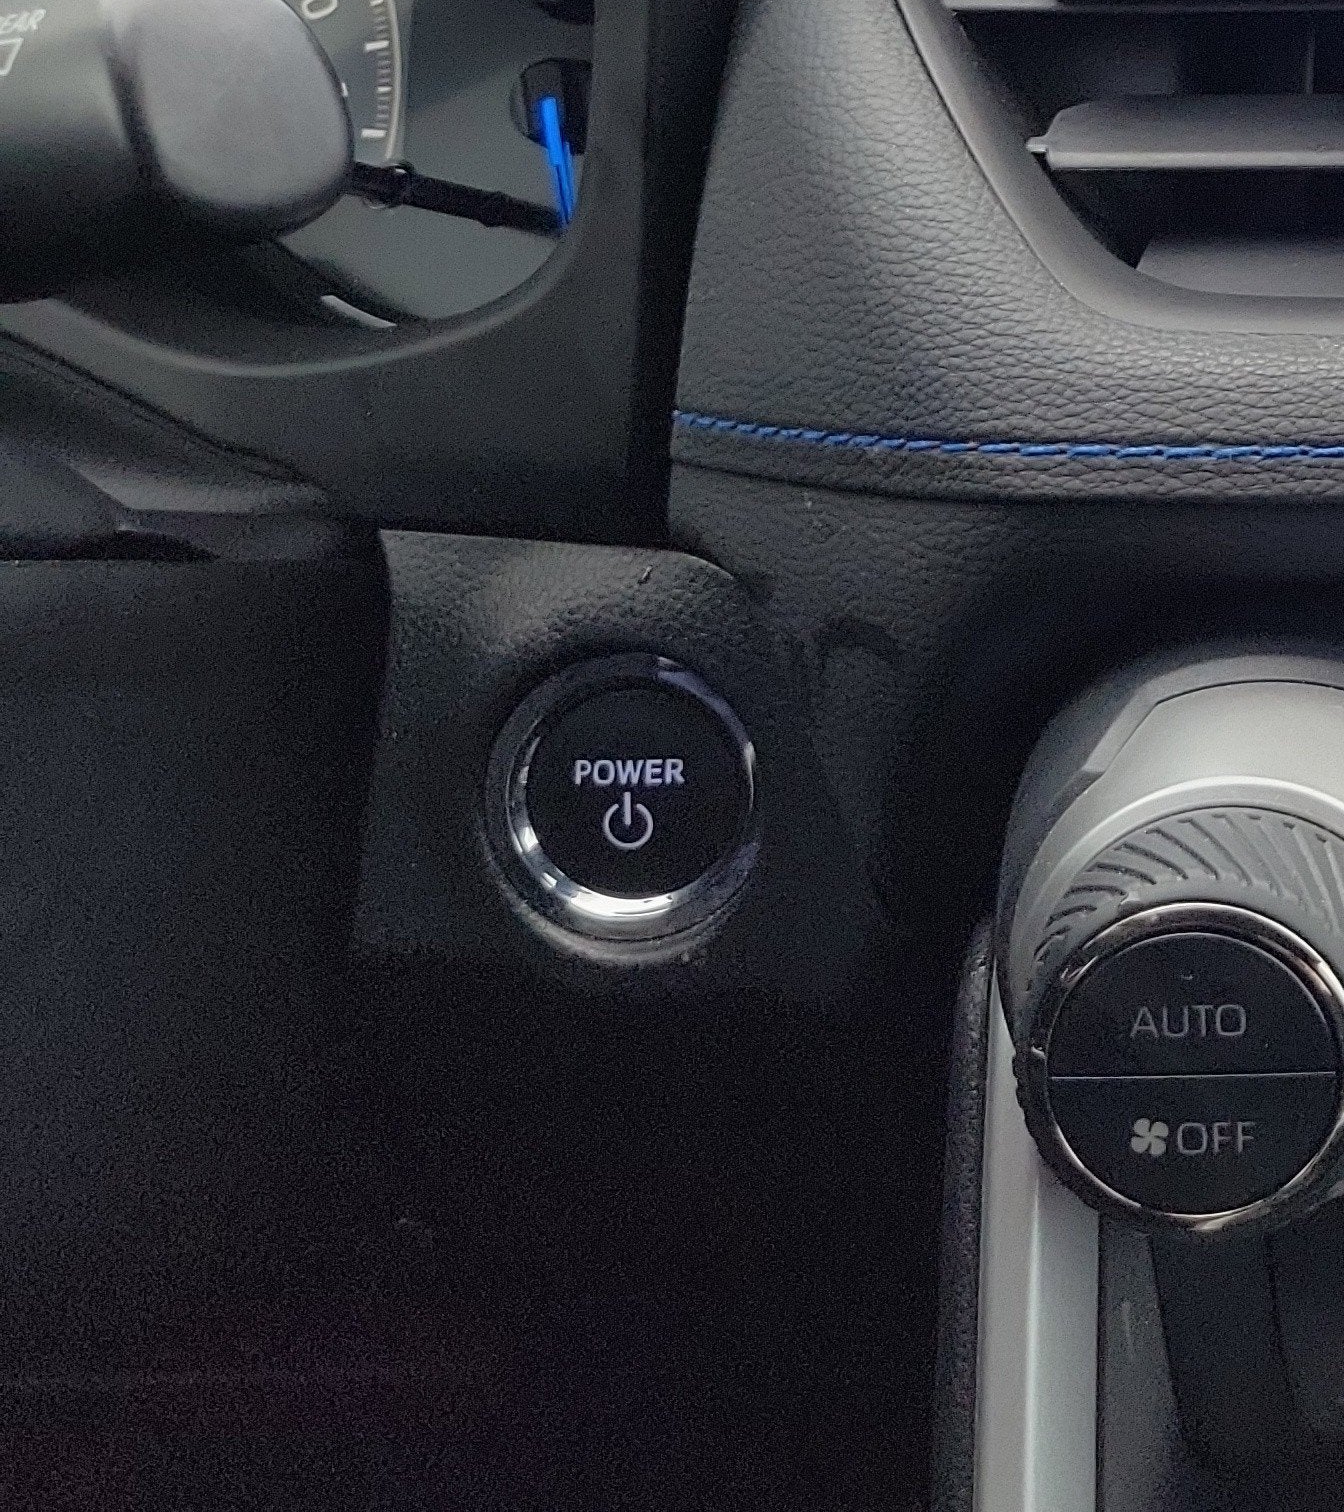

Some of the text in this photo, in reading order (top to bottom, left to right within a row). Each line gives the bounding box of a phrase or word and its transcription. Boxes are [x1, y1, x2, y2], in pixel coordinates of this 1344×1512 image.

[0, 9, 47, 35] EAR
[573, 758, 686, 786] POWER
[1129, 1003, 1248, 1039] AUTO
[1176, 1121, 1258, 1156] OFF
